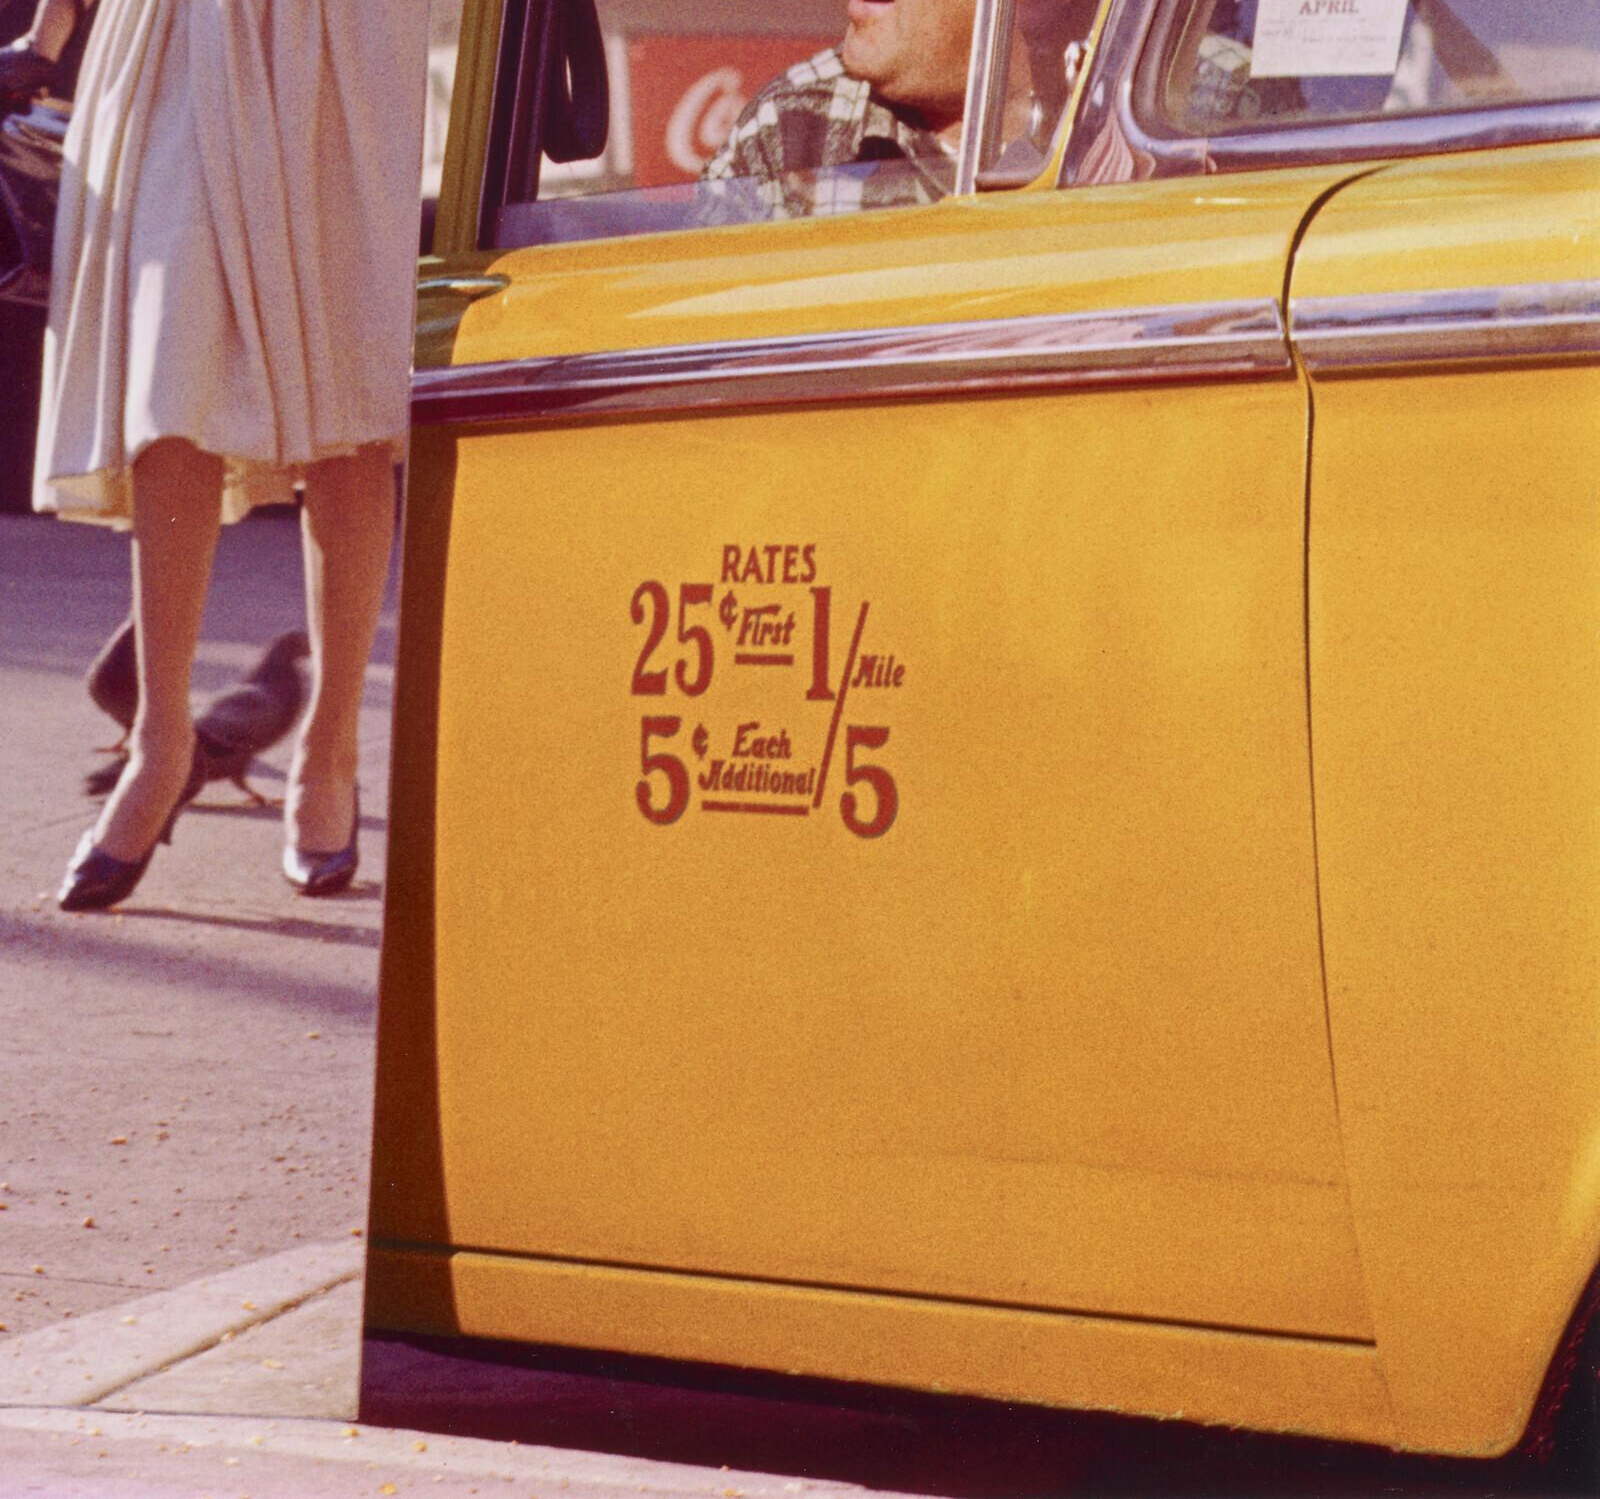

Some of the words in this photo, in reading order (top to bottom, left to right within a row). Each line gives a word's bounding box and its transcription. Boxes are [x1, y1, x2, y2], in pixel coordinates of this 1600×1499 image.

[720, 544, 817, 584] RATES
[736, 603, 796, 647] First
[851, 654, 906, 688] Mile
[732, 722, 793, 760] Each
[697, 759, 816, 796] Additional
